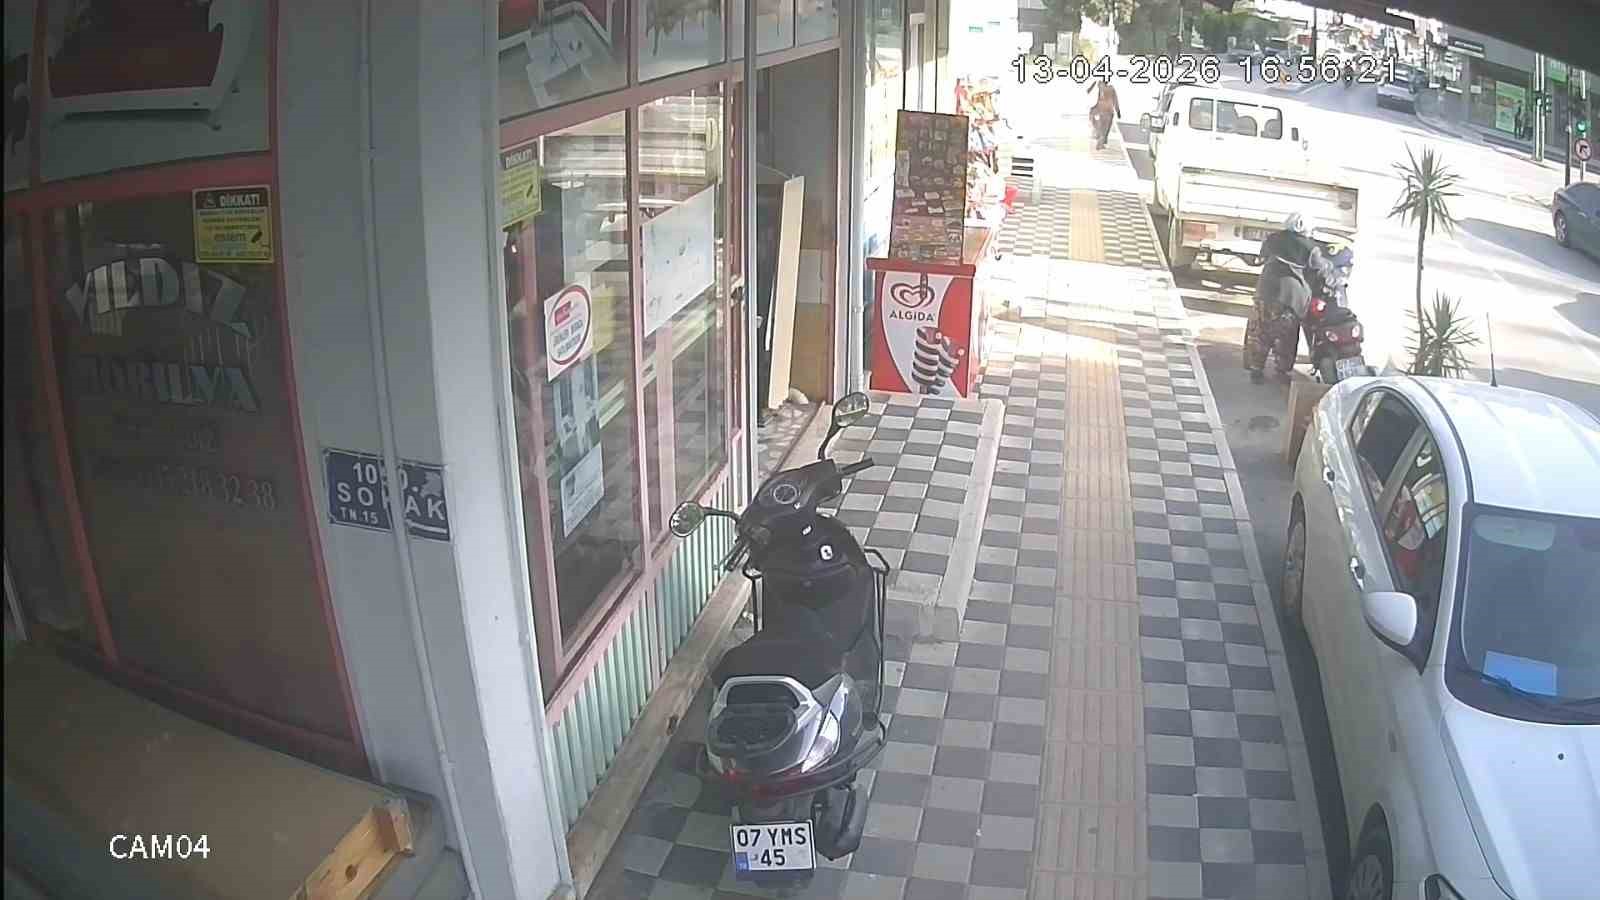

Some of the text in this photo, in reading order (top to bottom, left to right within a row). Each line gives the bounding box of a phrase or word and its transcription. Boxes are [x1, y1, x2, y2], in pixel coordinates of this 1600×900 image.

[889, 310, 935, 322] ALGIDA
[737, 827, 807, 847] 07 YMS
[760, 848, 786, 867] 45
